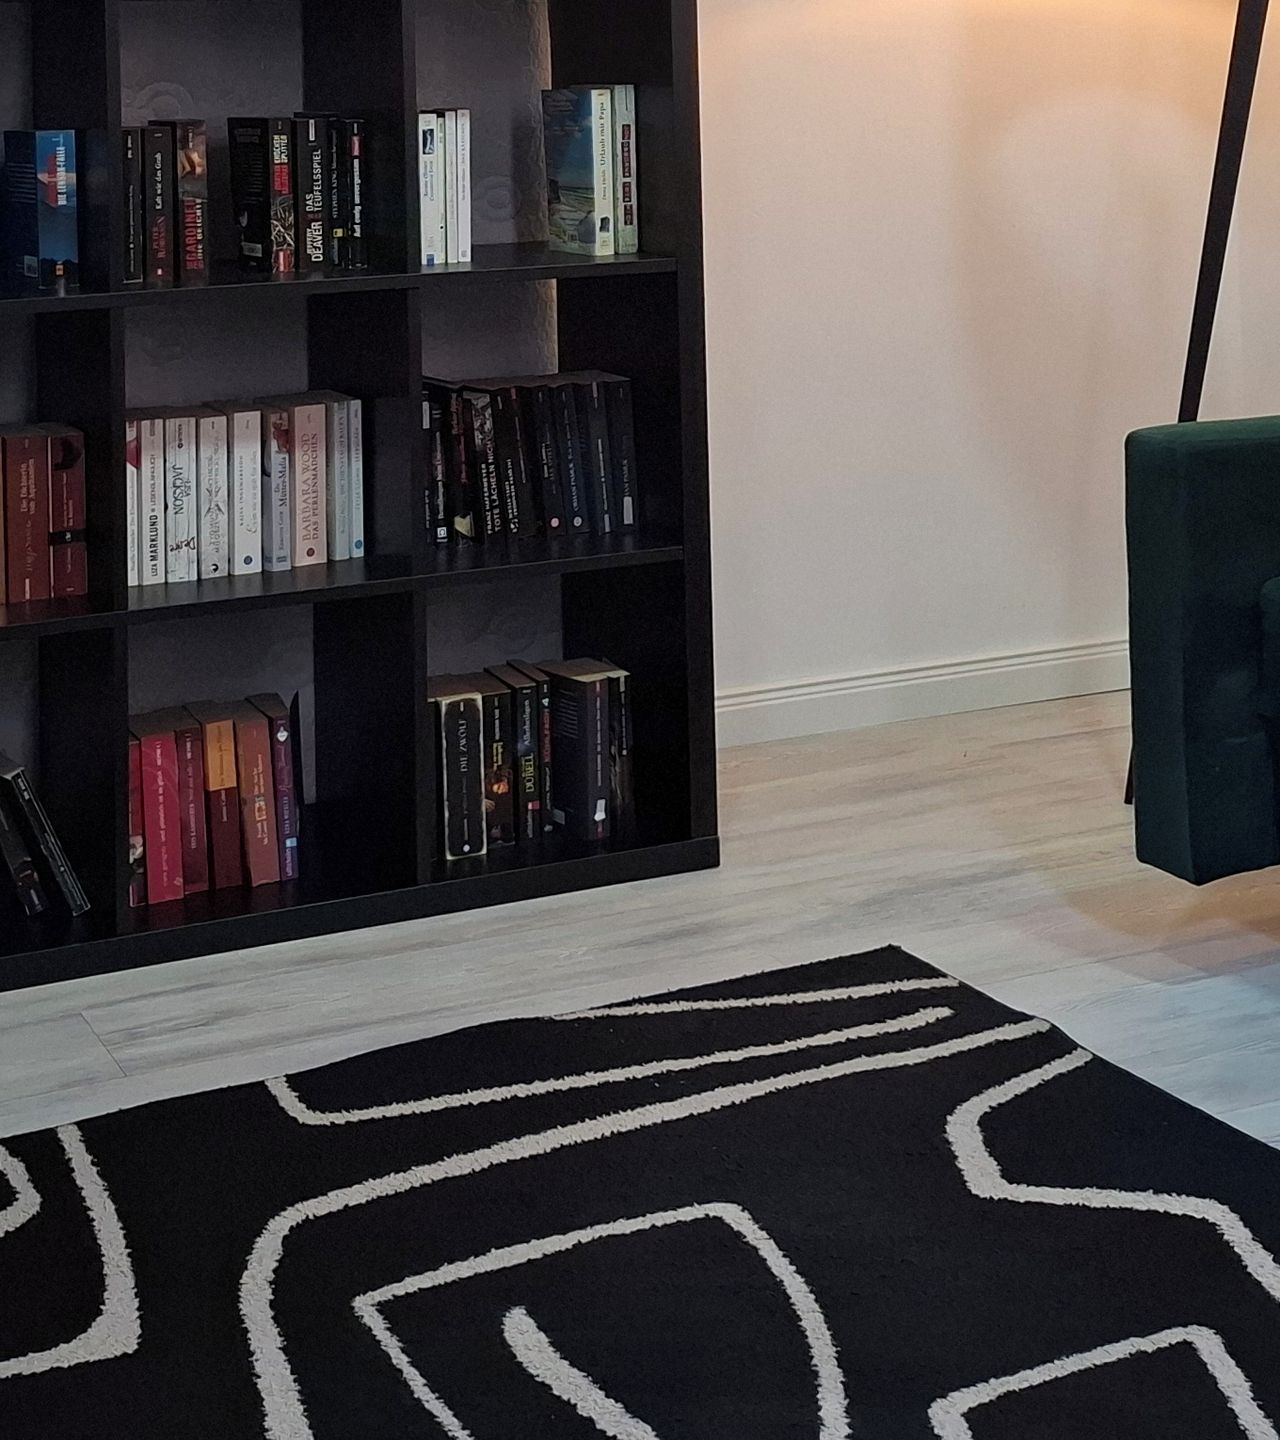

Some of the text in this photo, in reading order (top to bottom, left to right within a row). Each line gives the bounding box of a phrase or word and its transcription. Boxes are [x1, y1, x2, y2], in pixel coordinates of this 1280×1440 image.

[306, 193, 314, 212] DAS
[313, 149, 323, 212] TEUFELSSPIEL
[311, 221, 323, 262] DEAVER
[172, 465, 184, 515] JACKSON
[301, 433, 311, 541] BARBARA WOOD
[489, 464, 499, 506] LÄCHELN
[150, 515, 158, 562] MARKLUND
[493, 507, 502, 532] TOTE
